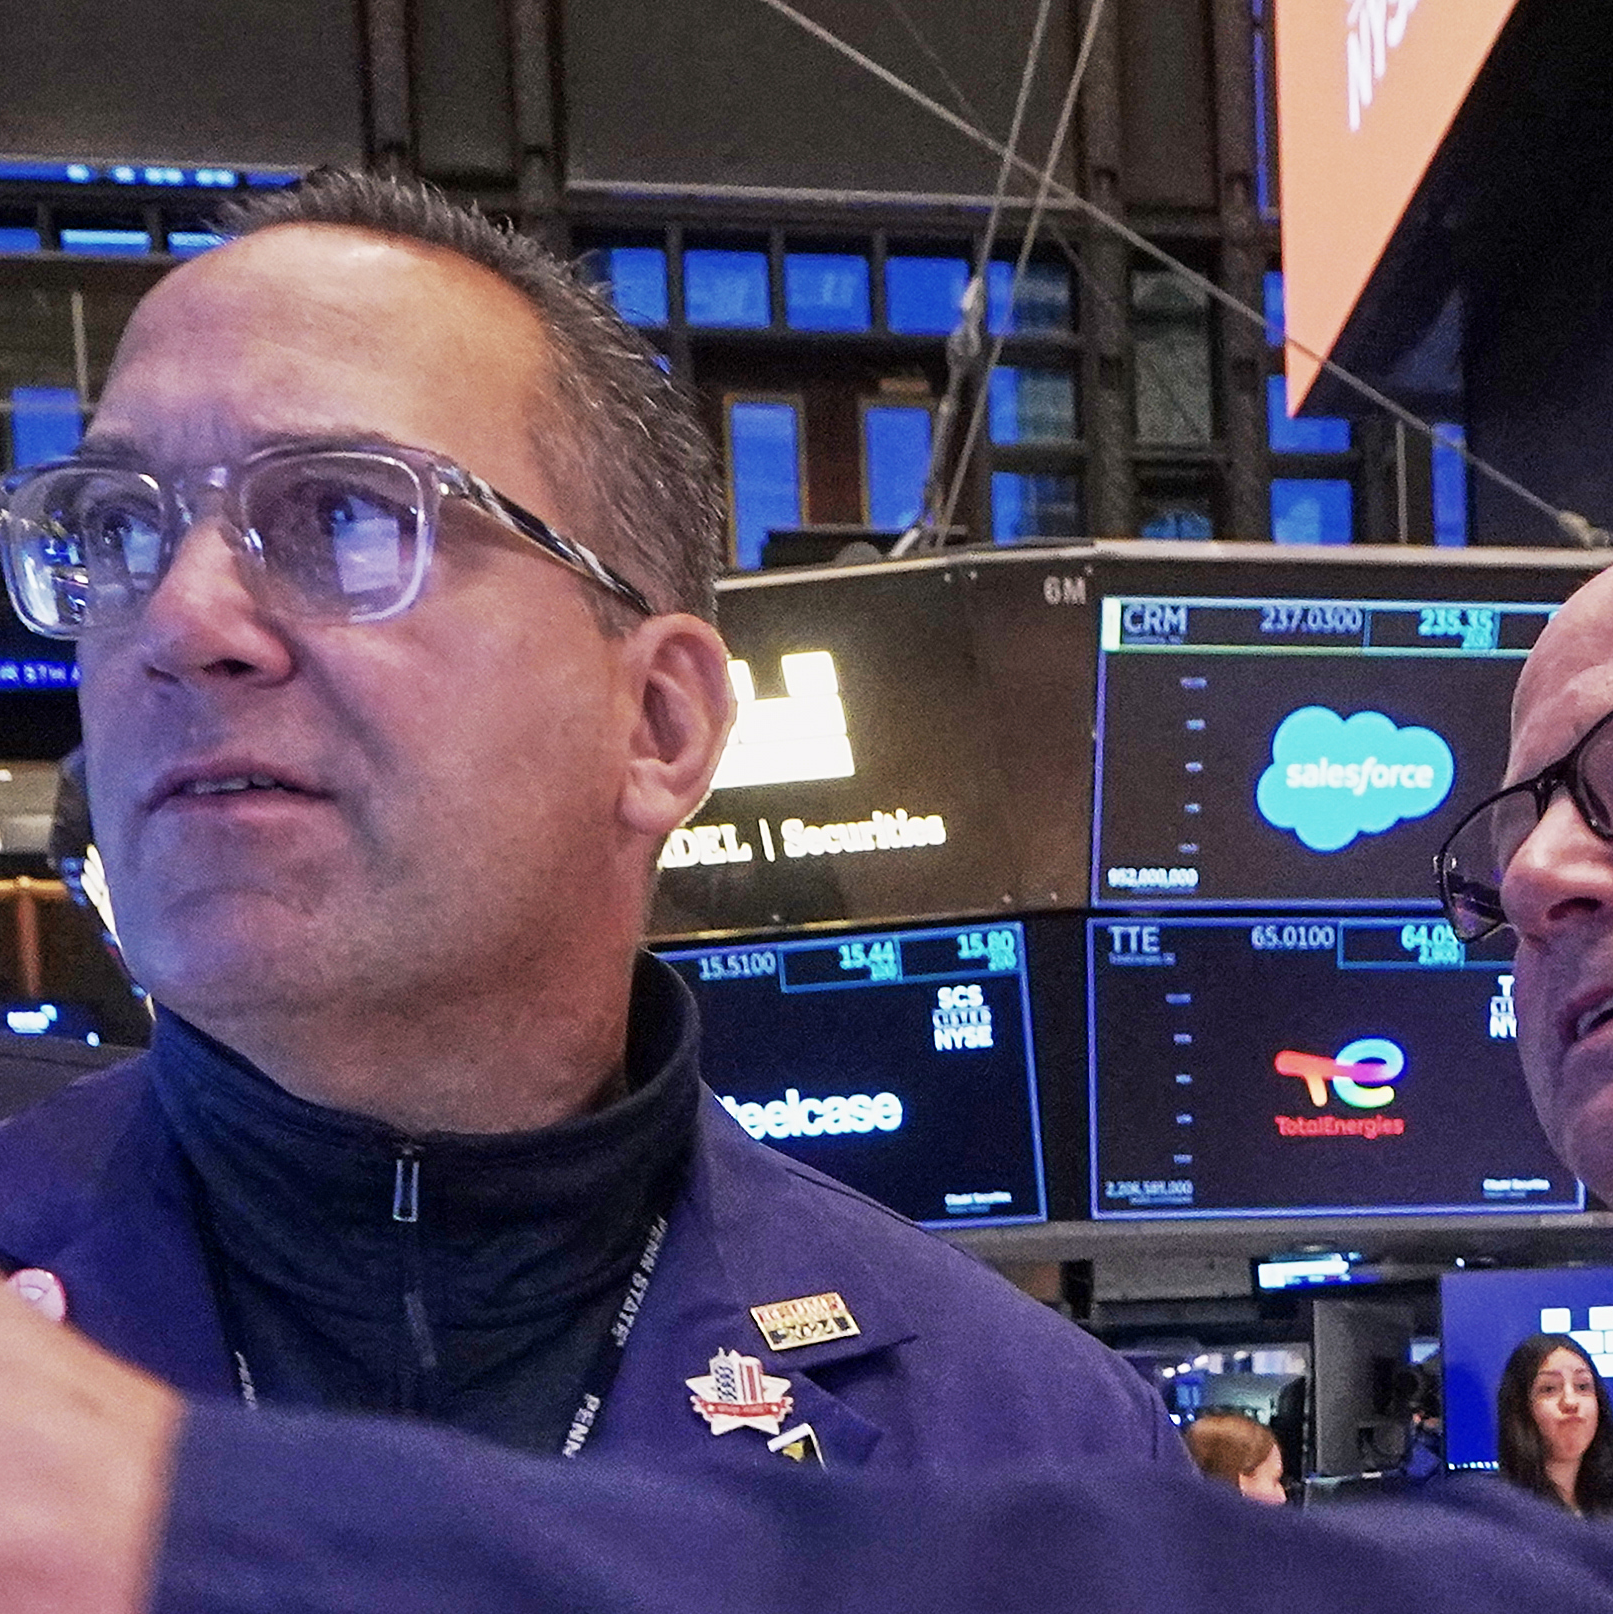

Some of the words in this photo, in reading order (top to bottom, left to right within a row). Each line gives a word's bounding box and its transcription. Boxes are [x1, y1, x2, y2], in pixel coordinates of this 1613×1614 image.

[1122, 603, 1189, 635] CRM
[1285, 756, 1435, 797] salesforce
[659, 822, 753, 869] ADEL
[780, 807, 947, 859] Securities
[1107, 924, 1161, 954] TTE
[1250, 923, 1337, 951] 65.0100
[698, 951, 777, 981] 15.5100
[937, 984, 984, 1010] SCS
[933, 1024, 994, 1051] NYSE
[1489, 1016, 1518, 1039] NY
[1274, 1113, 1405, 1140] TotalEnergies
